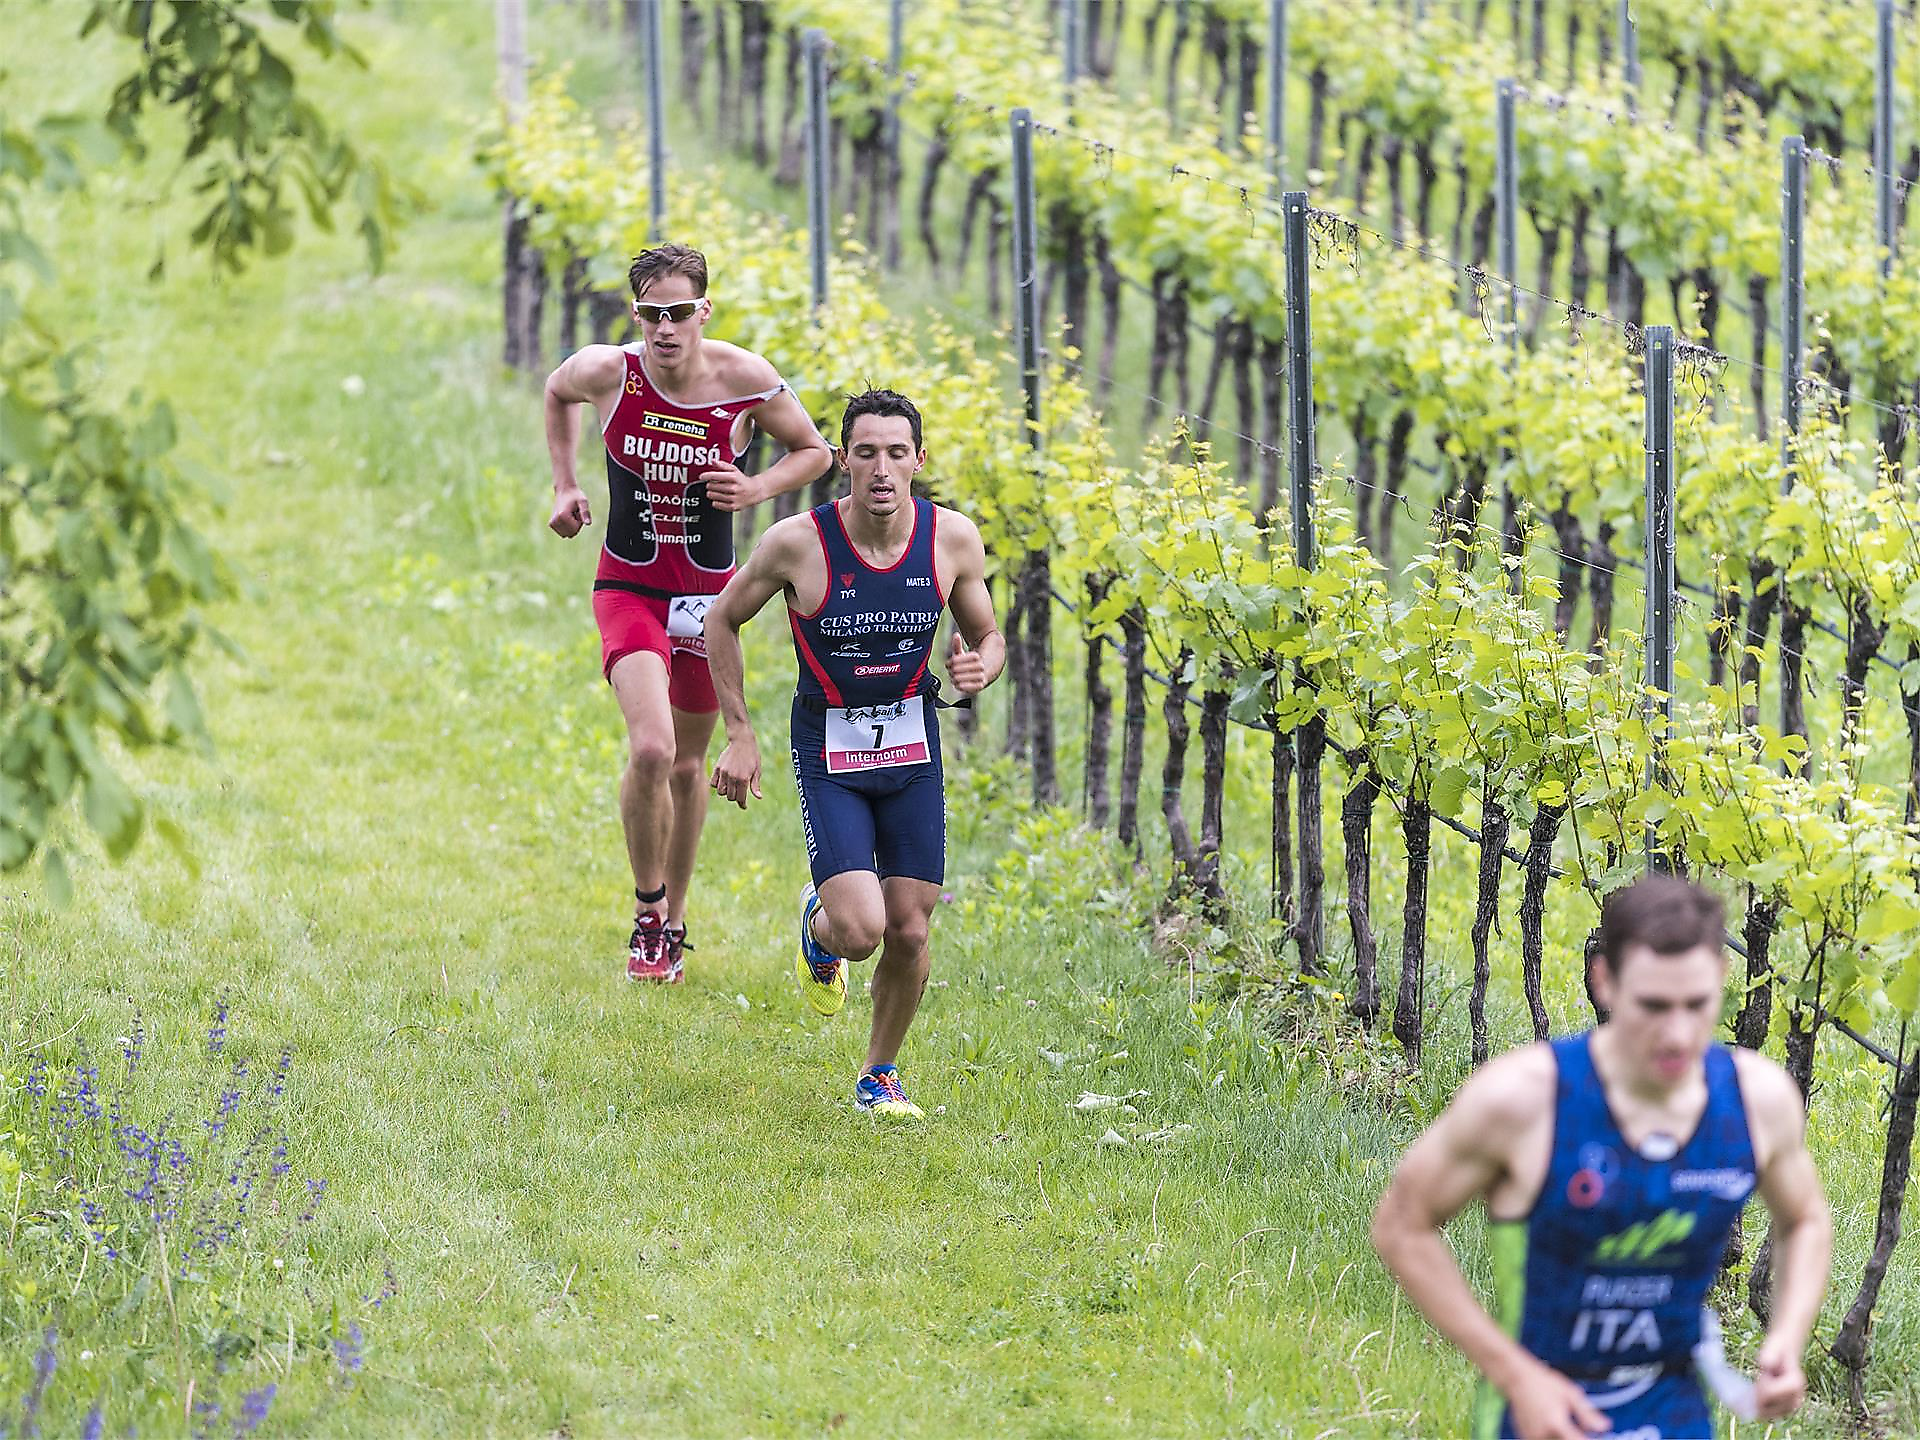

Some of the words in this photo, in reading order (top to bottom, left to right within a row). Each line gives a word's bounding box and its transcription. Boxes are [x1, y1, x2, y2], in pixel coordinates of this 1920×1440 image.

[663, 421, 705, 436] remeha
[643, 462, 688, 484] HUN
[906, 577, 926, 587] MATE
[925, 577, 931, 587] 3
[840, 589, 856, 600] TYR
[820, 615, 853, 629] CUS
[855, 611, 887, 626] PRO
[890, 610, 939, 624] PATRIA
[820, 624, 871, 637] MILANO
[871, 724, 884, 749] 7
[845, 747, 908, 764] Internorm
[1569, 1308, 1663, 1352] ITA
